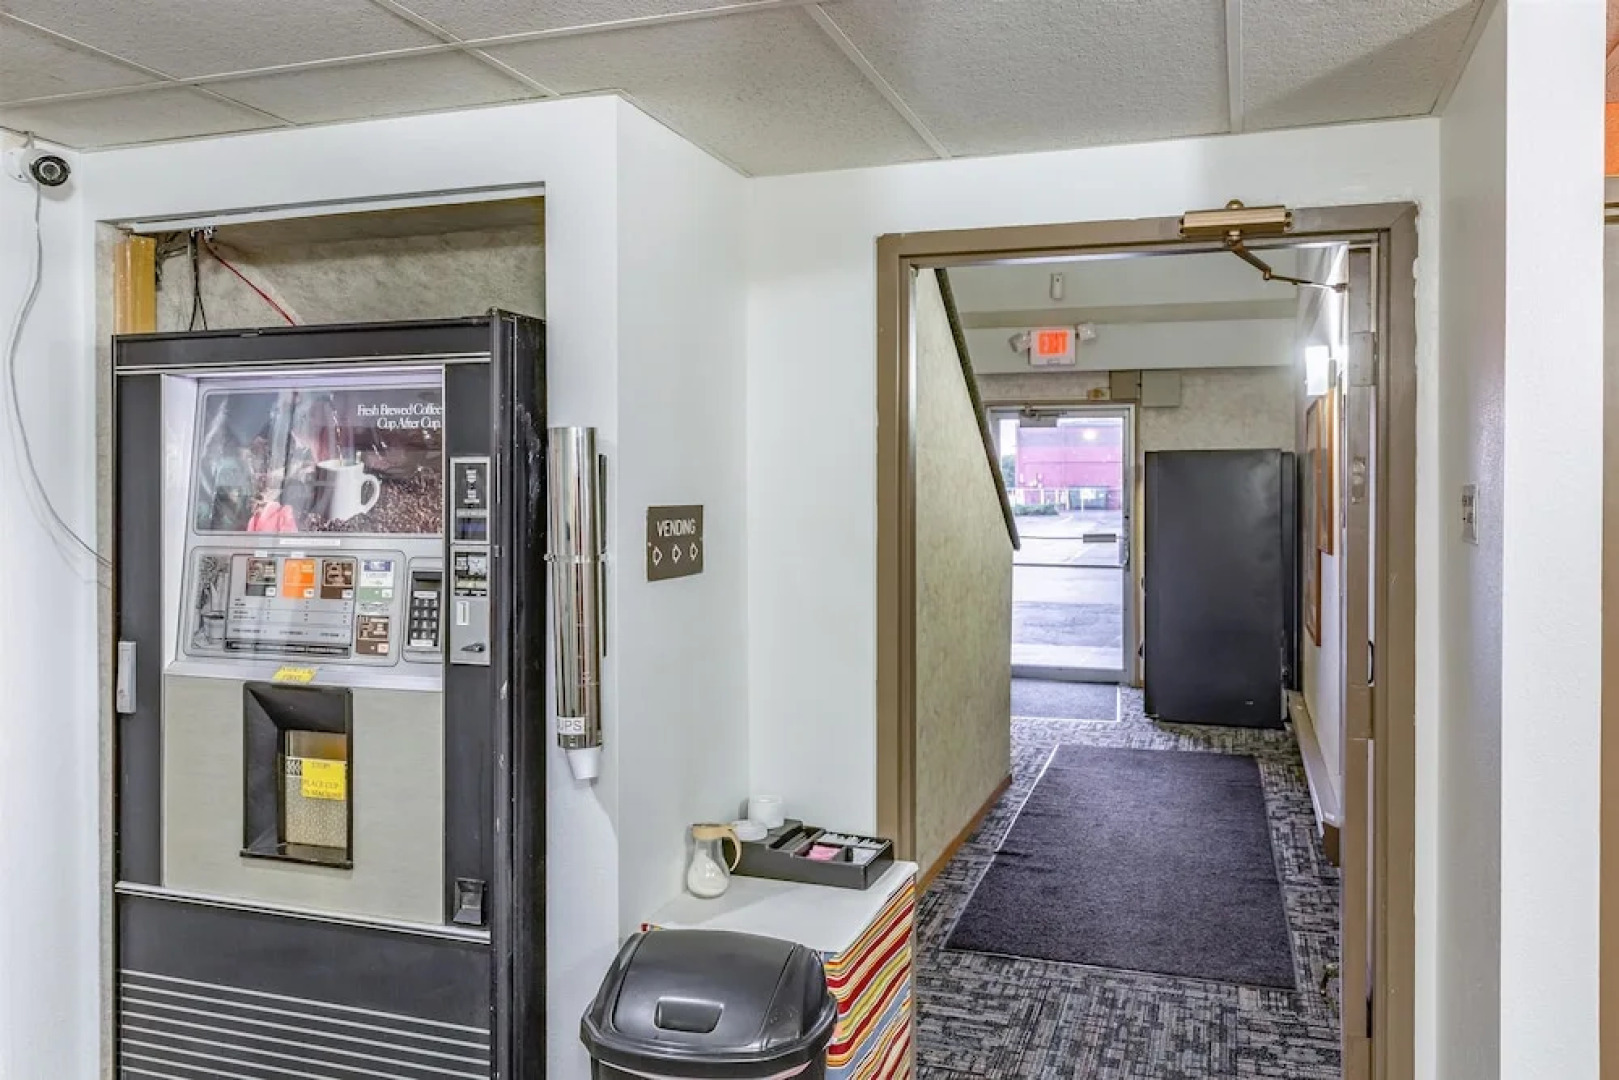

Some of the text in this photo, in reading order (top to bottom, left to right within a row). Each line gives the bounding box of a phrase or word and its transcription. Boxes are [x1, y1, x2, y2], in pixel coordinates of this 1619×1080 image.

[357, 403, 379, 416] Fresh
[380, 403, 412, 415] Brewed
[397, 417, 419, 428] After
[656, 518, 696, 537] VENDING
